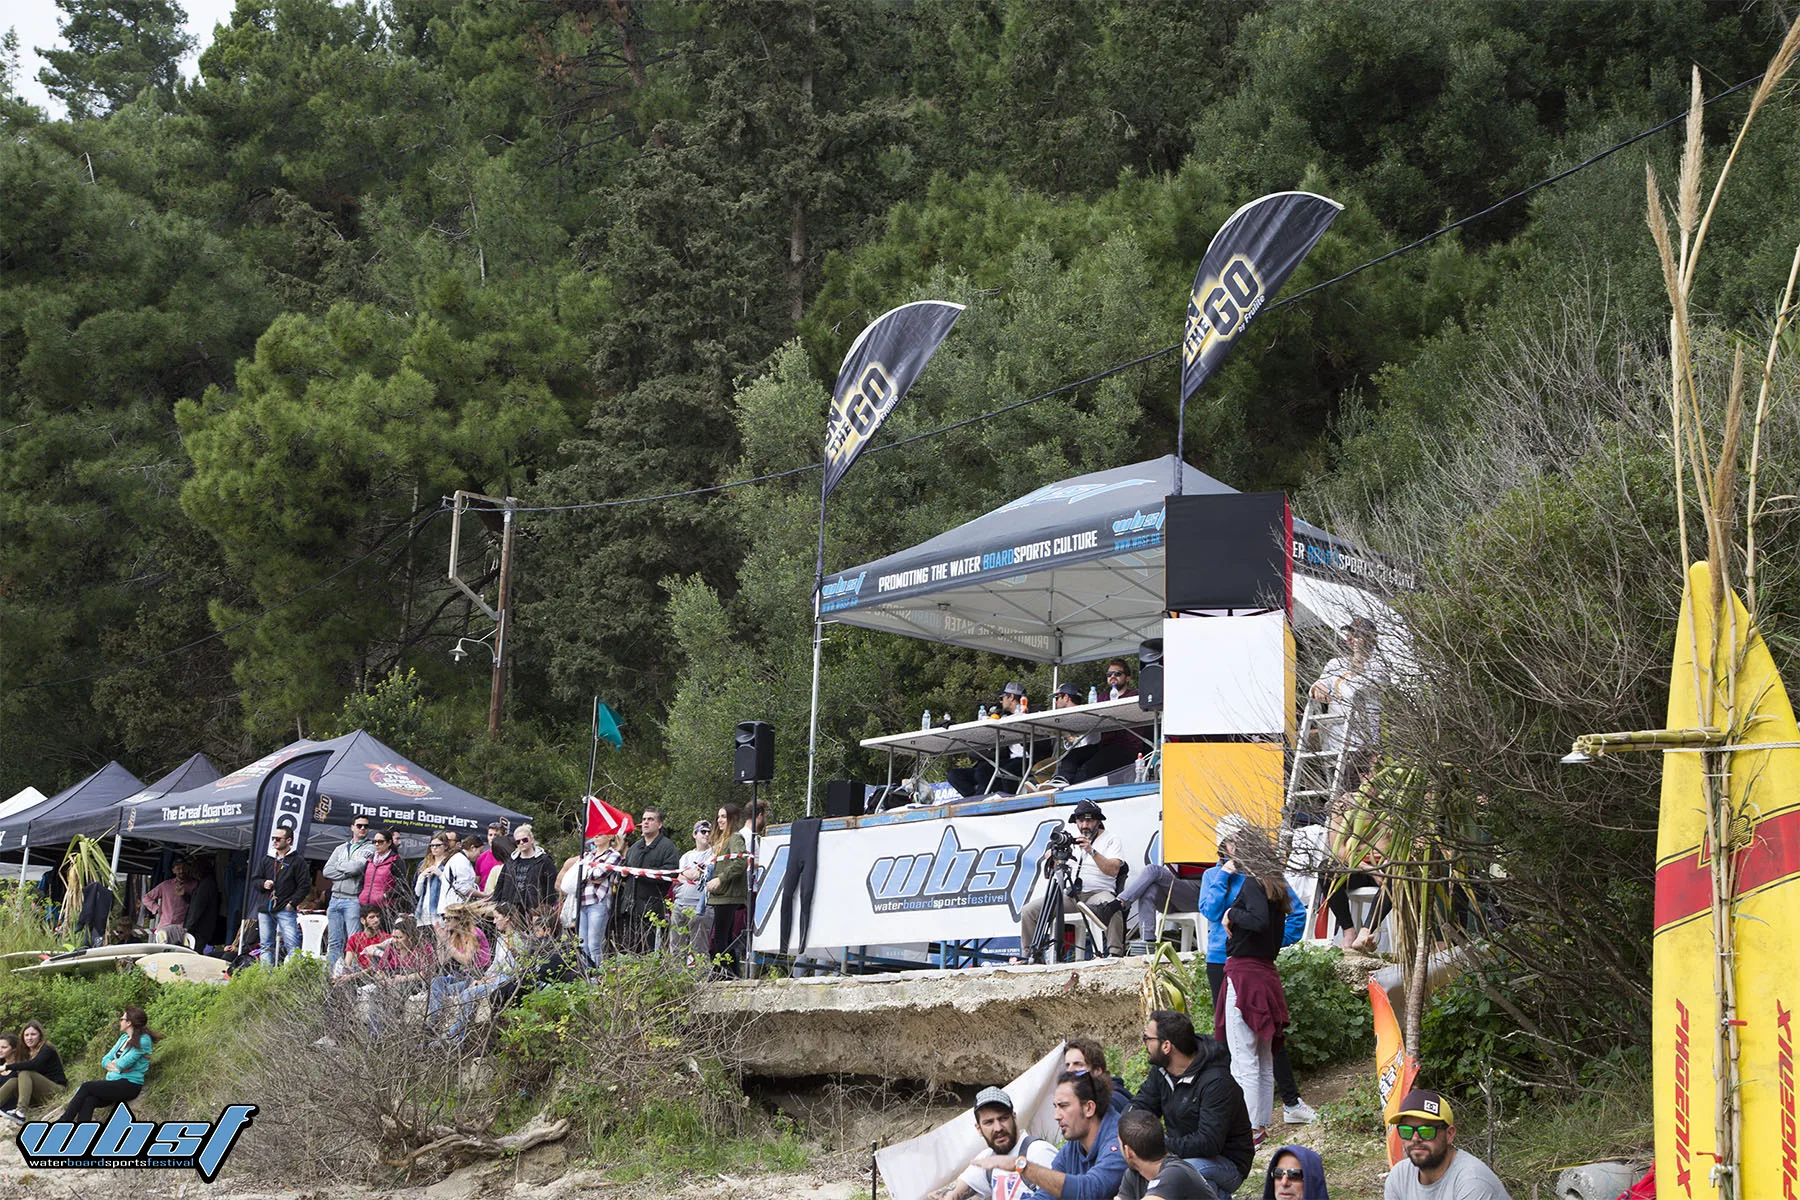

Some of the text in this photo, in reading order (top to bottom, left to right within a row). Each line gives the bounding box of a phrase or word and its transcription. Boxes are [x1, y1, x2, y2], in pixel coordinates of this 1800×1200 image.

[1203, 259, 1260, 336] GO
[1184, 317, 1211, 356] THE
[845, 366, 893, 437] GO
[829, 421, 852, 454] THE
[878, 567, 929, 593] PROMOTING
[931, 563, 949, 581] THE
[950, 555, 981, 577] WATER
[983, 541, 1051, 571] BOARDSPORTS
[1053, 530, 1098, 555] CULTURE
[162, 801, 242, 820] The Great Boarders
[350, 803, 478, 829] The Great Boarders
[868, 822, 1063, 921] wbsf
[874, 891, 1008, 912] waterboardsportsfestival
[1675, 998, 1692, 1199] PHOENIX
